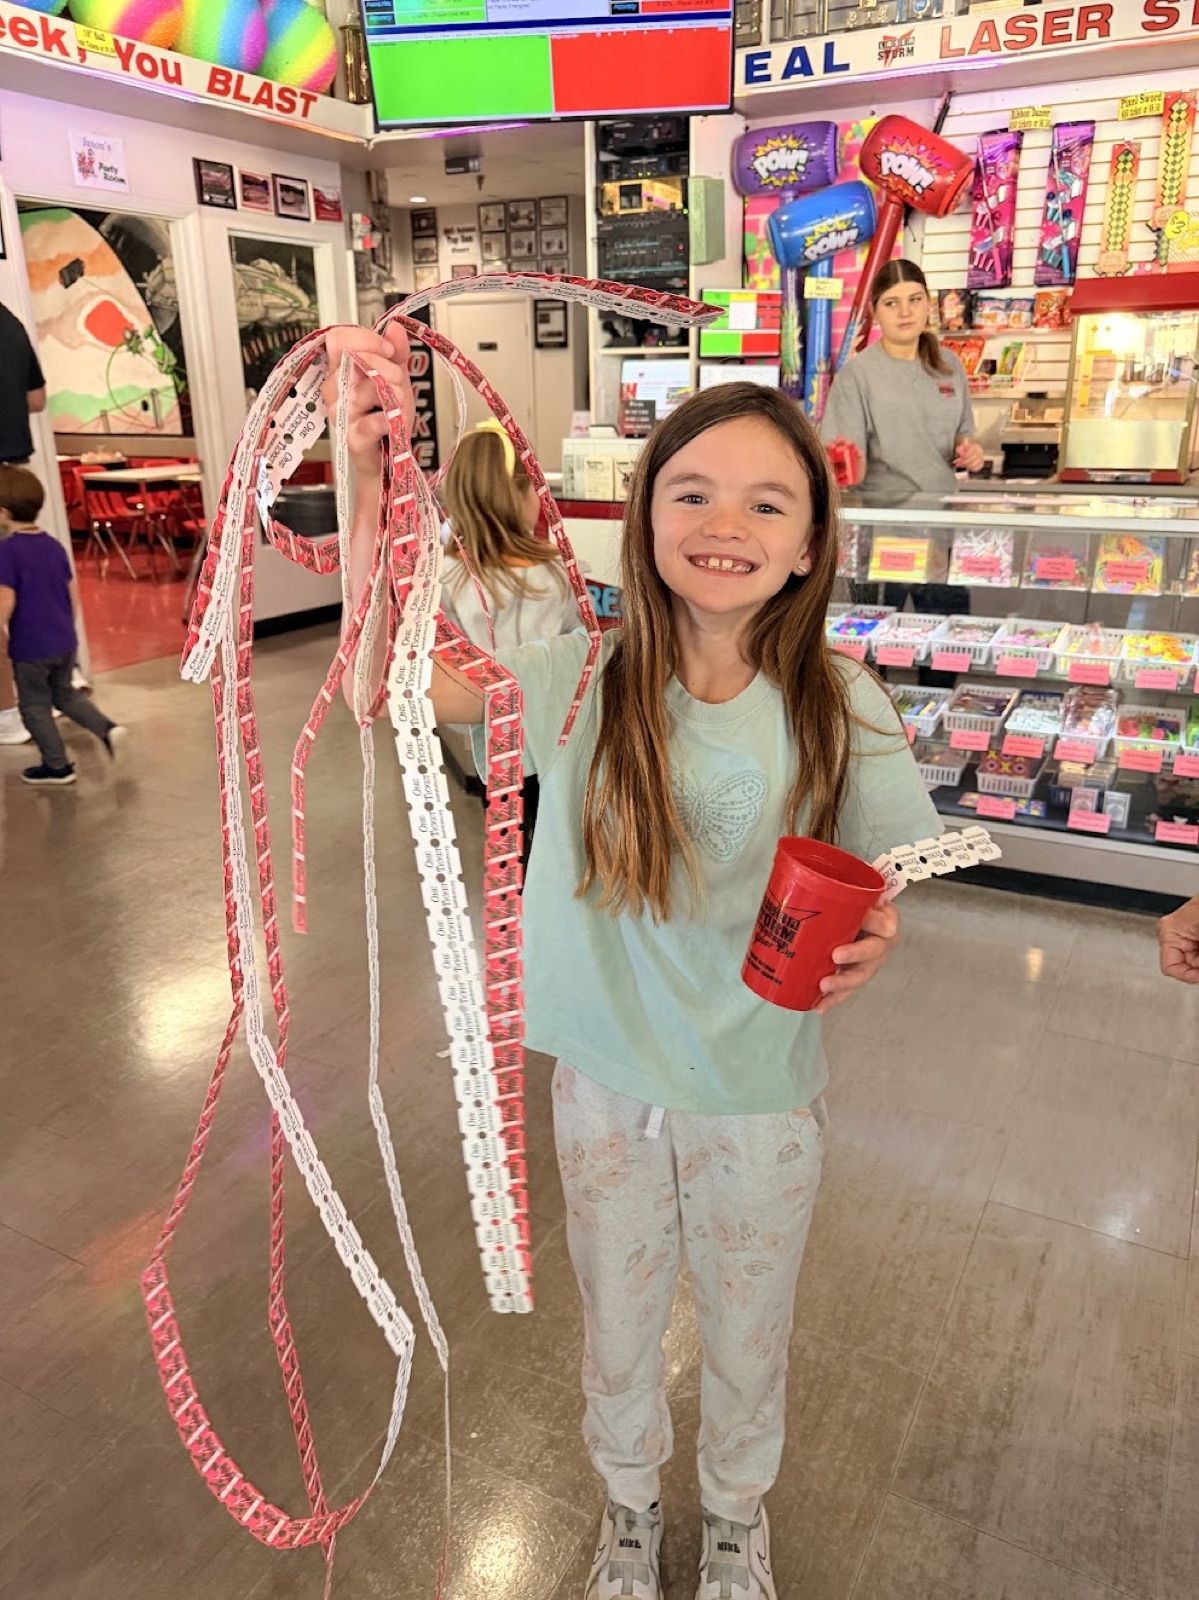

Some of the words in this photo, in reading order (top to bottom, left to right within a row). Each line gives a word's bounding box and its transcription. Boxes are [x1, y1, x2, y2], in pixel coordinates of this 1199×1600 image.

[939, 3, 1112, 60] LASER
[744, 41, 850, 85] EAL
[878, 46, 915, 61] STORM
[113, 38, 182, 86] You
[207, 66, 318, 119] BLAST
[98, 162, 118, 175] Party
[753, 148, 810, 180] POW!
[880, 150, 935, 194] POW!
[104, 172, 126, 184] Room
[804, 227, 860, 261] POW!
[402, 628, 412, 646] ONE
[396, 664, 406, 684] ONE
[406, 658, 416, 688] TICKET
[398, 702, 406, 722] ONE
[410, 700, 418, 726] TICKET
[406, 742, 414, 760] ONE
[416, 738, 426, 766] TICKET
[412, 778, 422, 796] ONE
[424, 774, 432, 804] TICKET
[418, 816, 428, 832] ONE
[430, 812, 438, 838] TICKET
[424, 850, 434, 868] ONE
[618, 1538, 642, 1548] NIKE
[717, 1542, 741, 1554] NIKE
